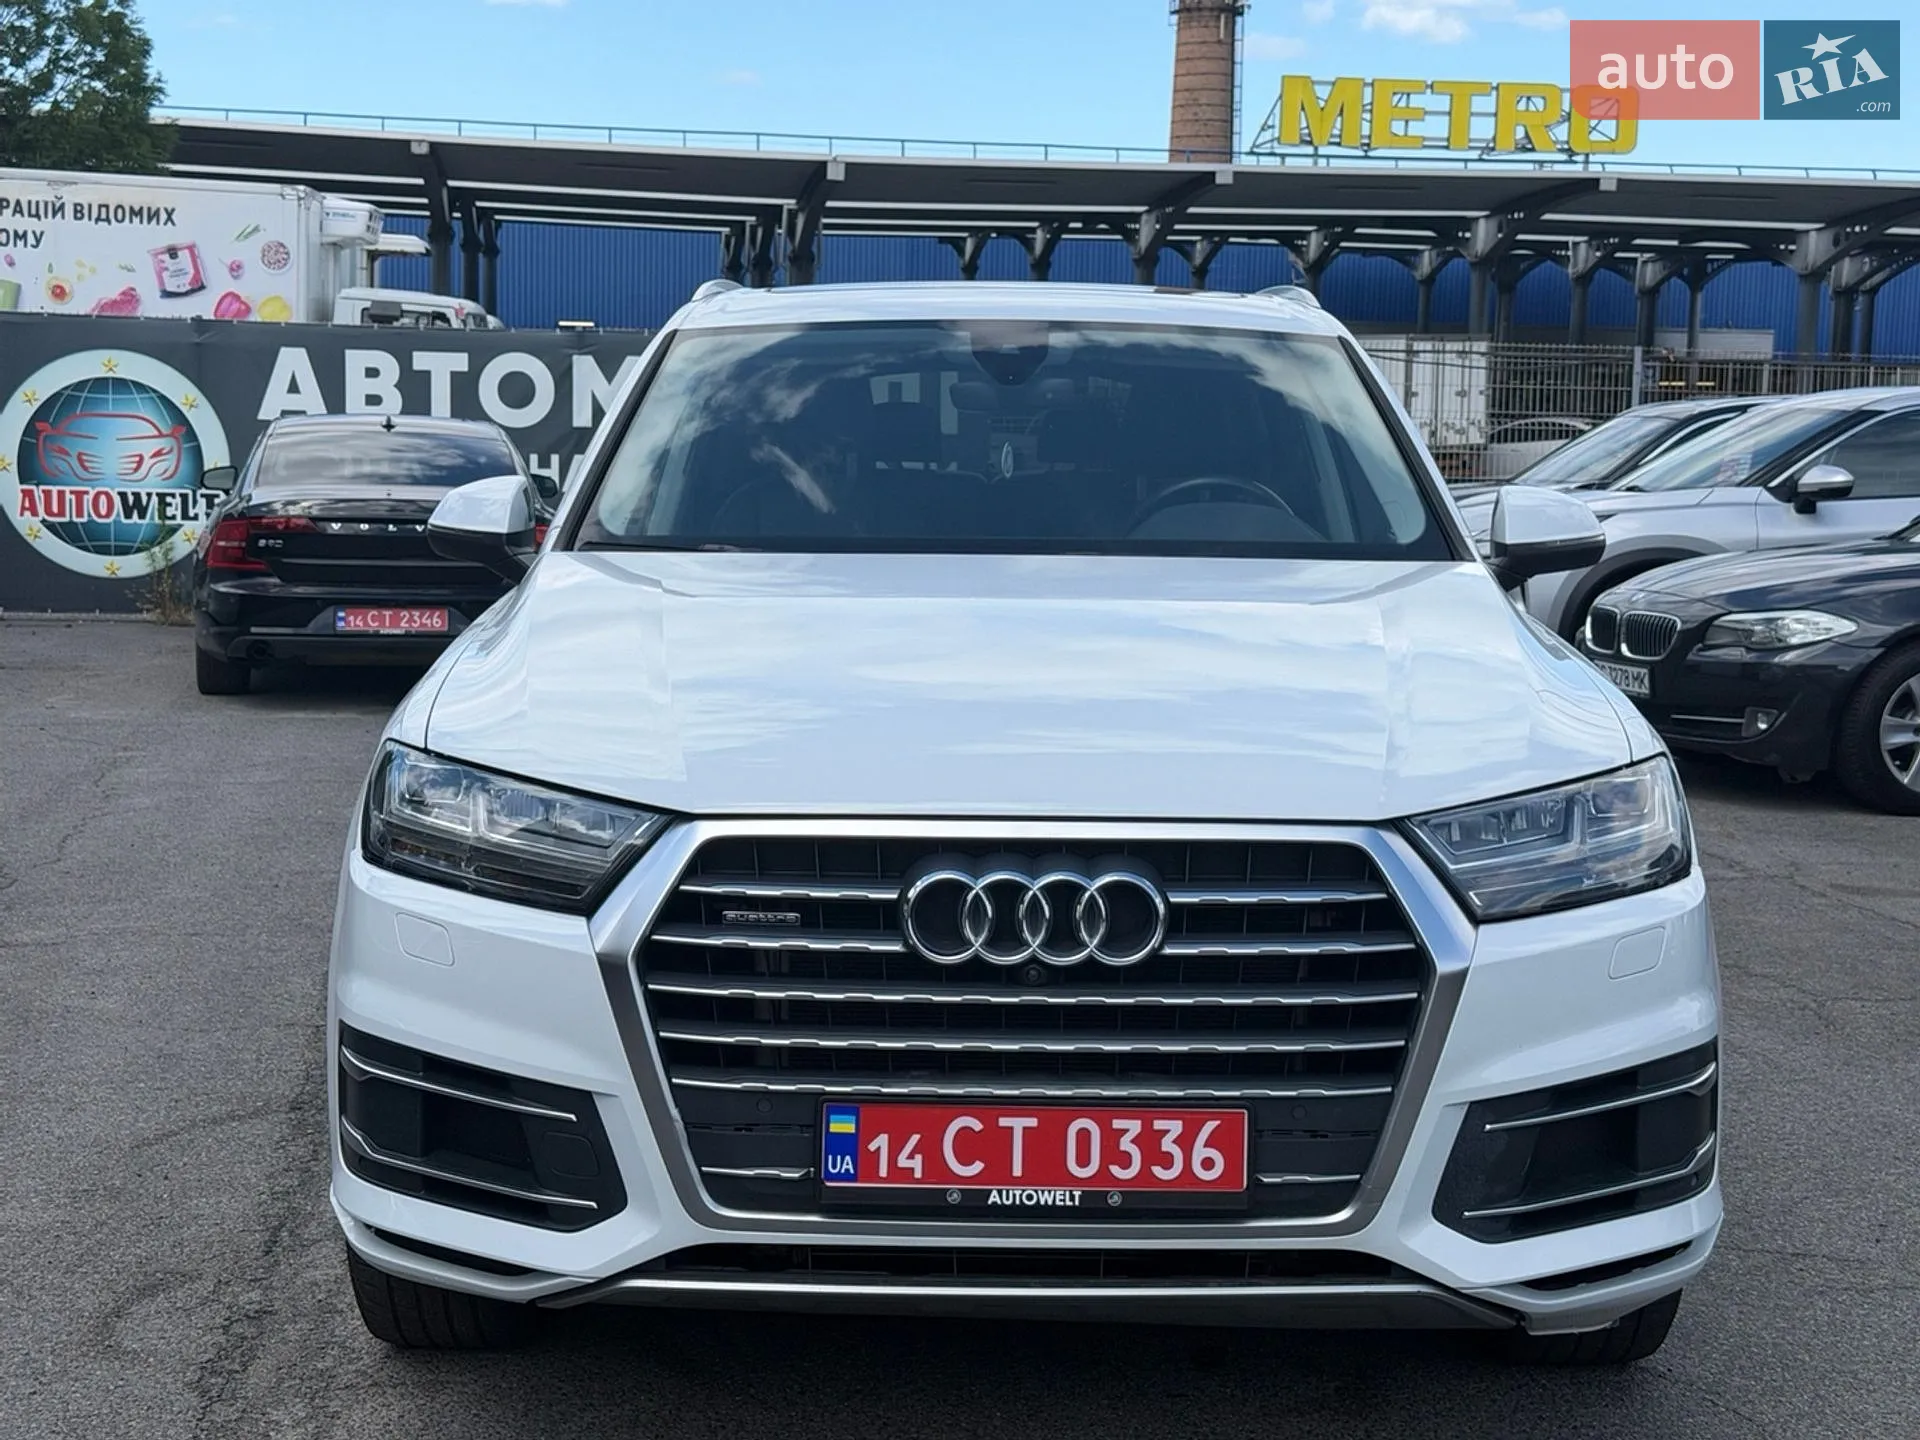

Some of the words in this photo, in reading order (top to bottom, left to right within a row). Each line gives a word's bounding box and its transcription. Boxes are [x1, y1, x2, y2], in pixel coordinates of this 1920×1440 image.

[1278, 75, 1640, 155] METRO
[73, 202, 176, 226] ВІДОМИХ
[257, 346, 641, 428] АВТОМ
[18, 486, 222, 522] AUTOWELT
[331, 522, 425, 532] VOLV
[348, 615, 364, 627] 14
[367, 611, 393, 627] CT
[400, 611, 442, 628] 2346
[867, 1133, 923, 1179] 14
[942, 1115, 1038, 1178] CT
[1066, 1117, 1225, 1181] 0336
[828, 1154, 854, 1174] UA
[987, 1189, 1083, 1206] AUTOWELT
